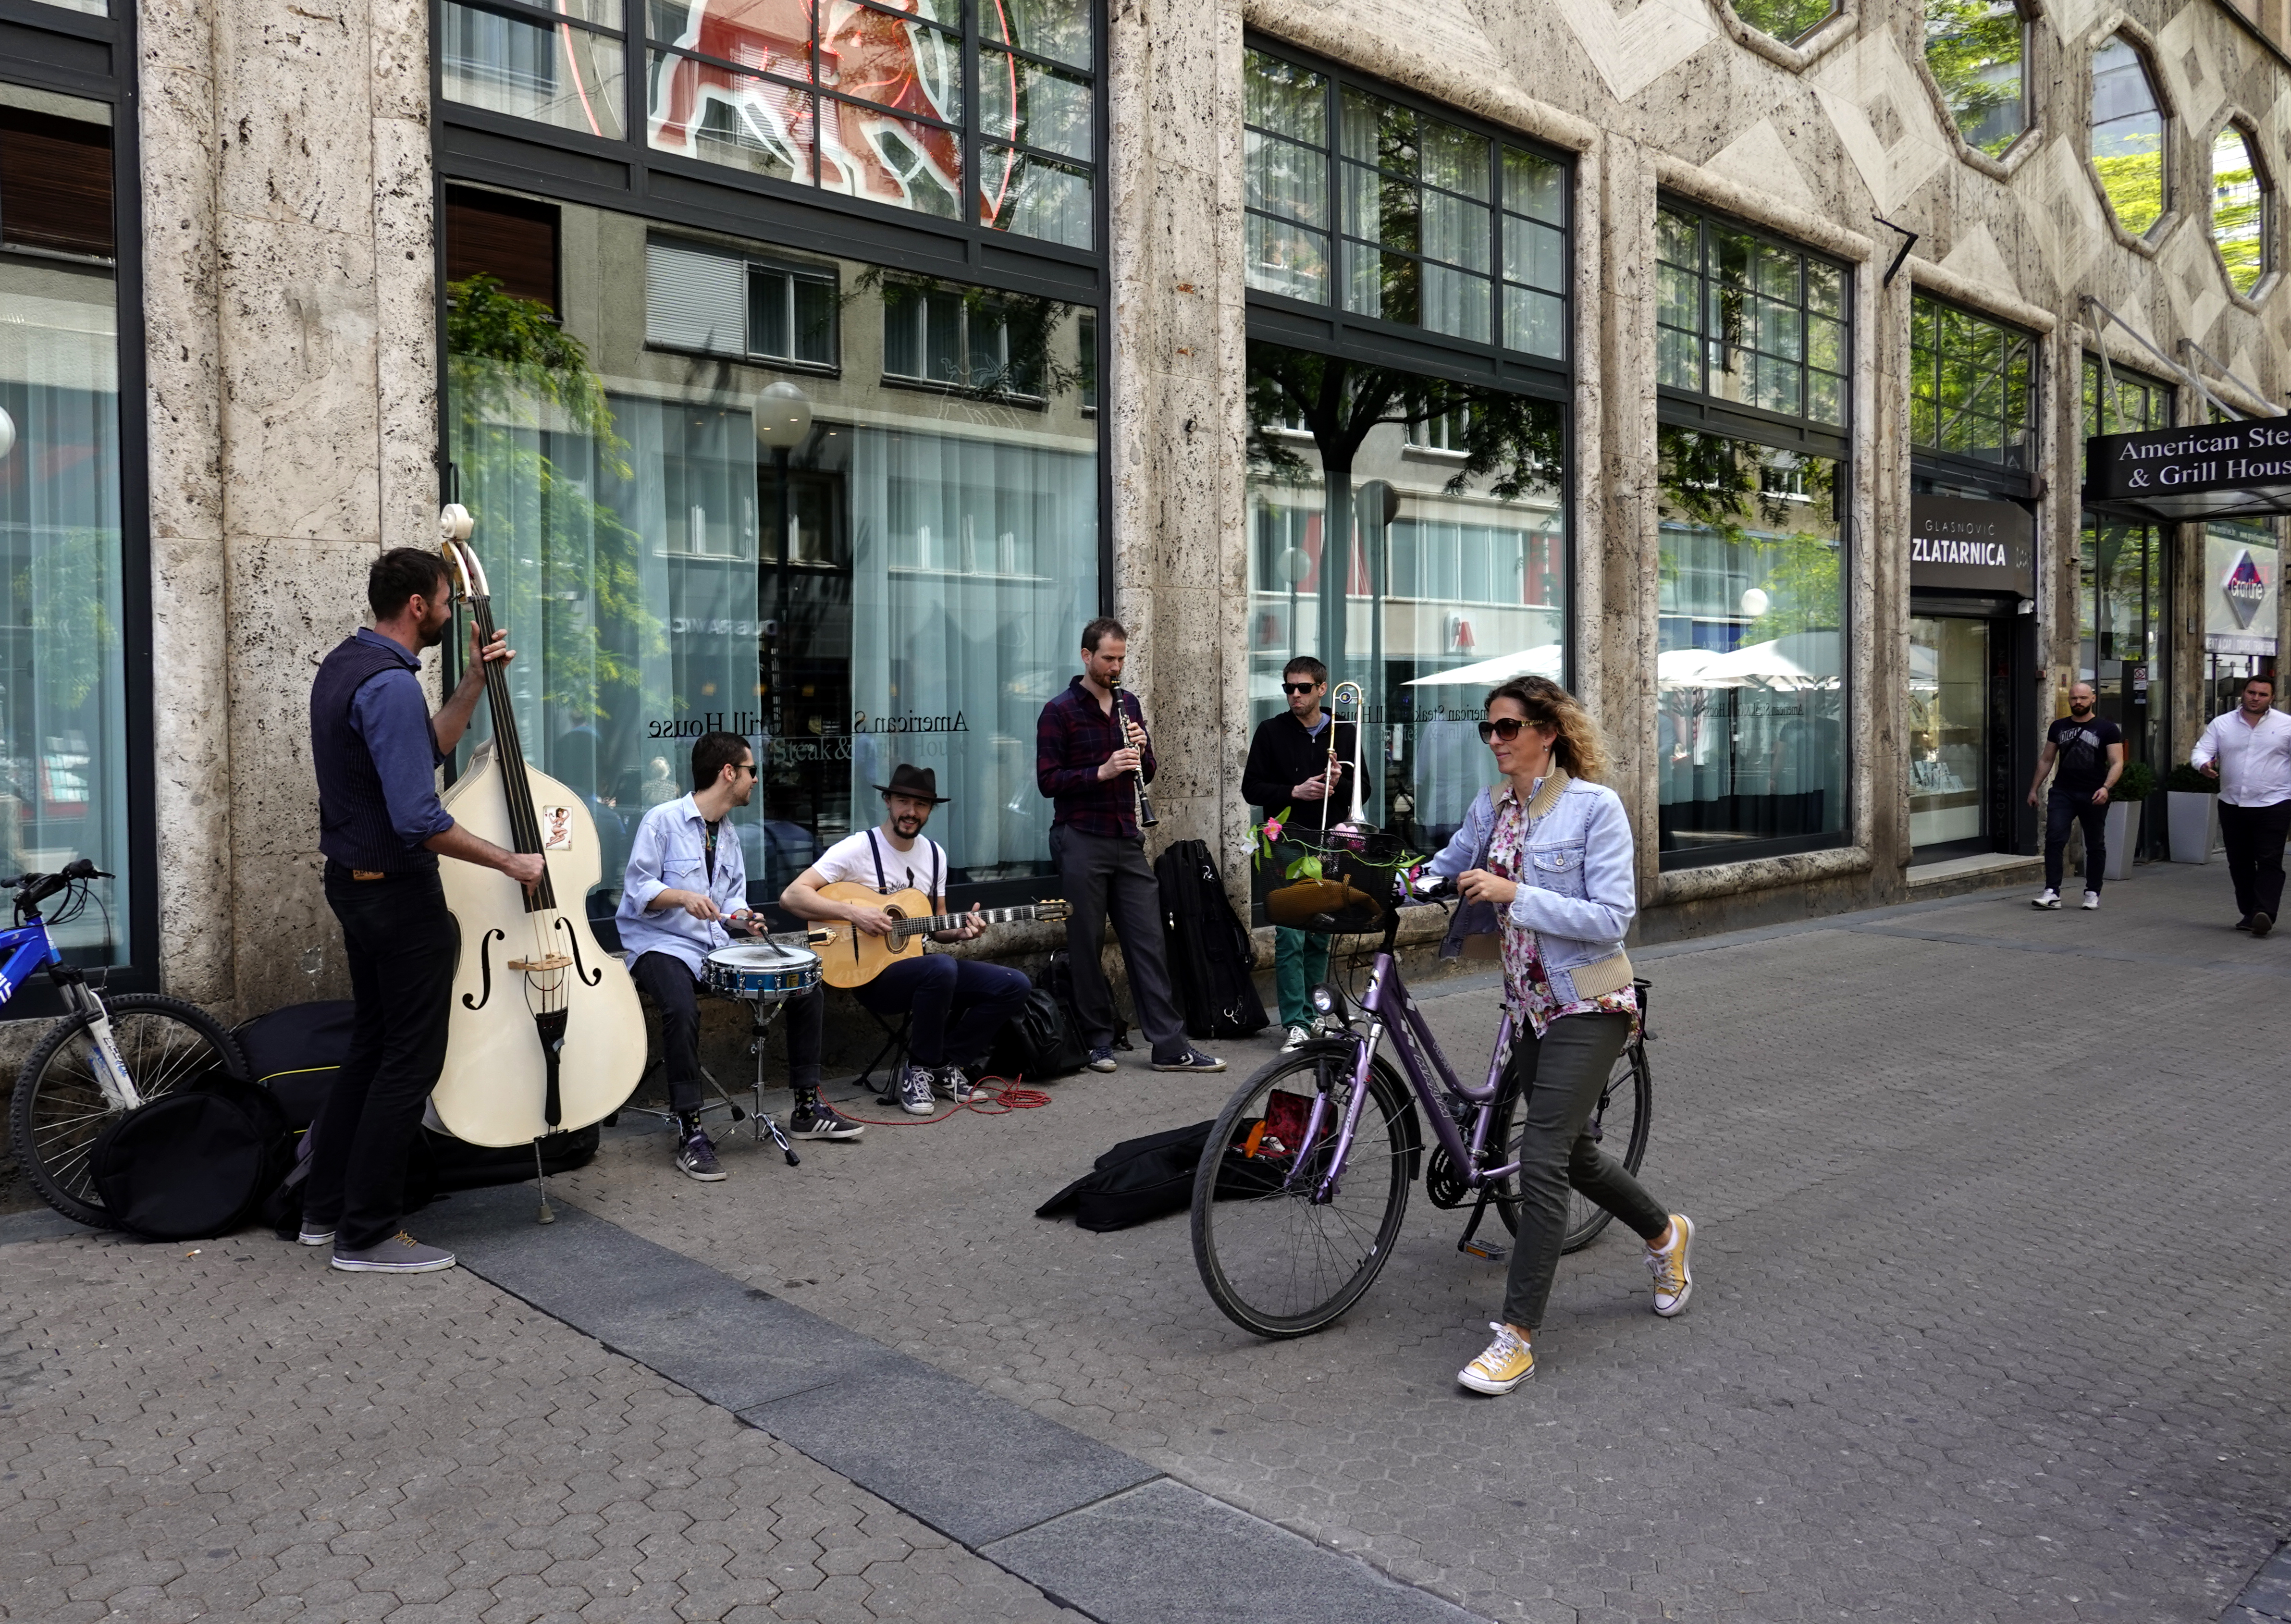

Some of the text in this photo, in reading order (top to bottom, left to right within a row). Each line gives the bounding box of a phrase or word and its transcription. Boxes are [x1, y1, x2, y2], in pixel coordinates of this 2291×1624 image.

[2118, 428, 2291, 461] American Ste
[2128, 468, 2151, 488] &
[2159, 461, 2217, 485] Grill
[1925, 520, 1995, 536] GLASNOVIĆ
[1912, 538, 2006, 566] ZLATARNICA
[774, 737, 832, 764] Steak
[835, 737, 852, 760] &
